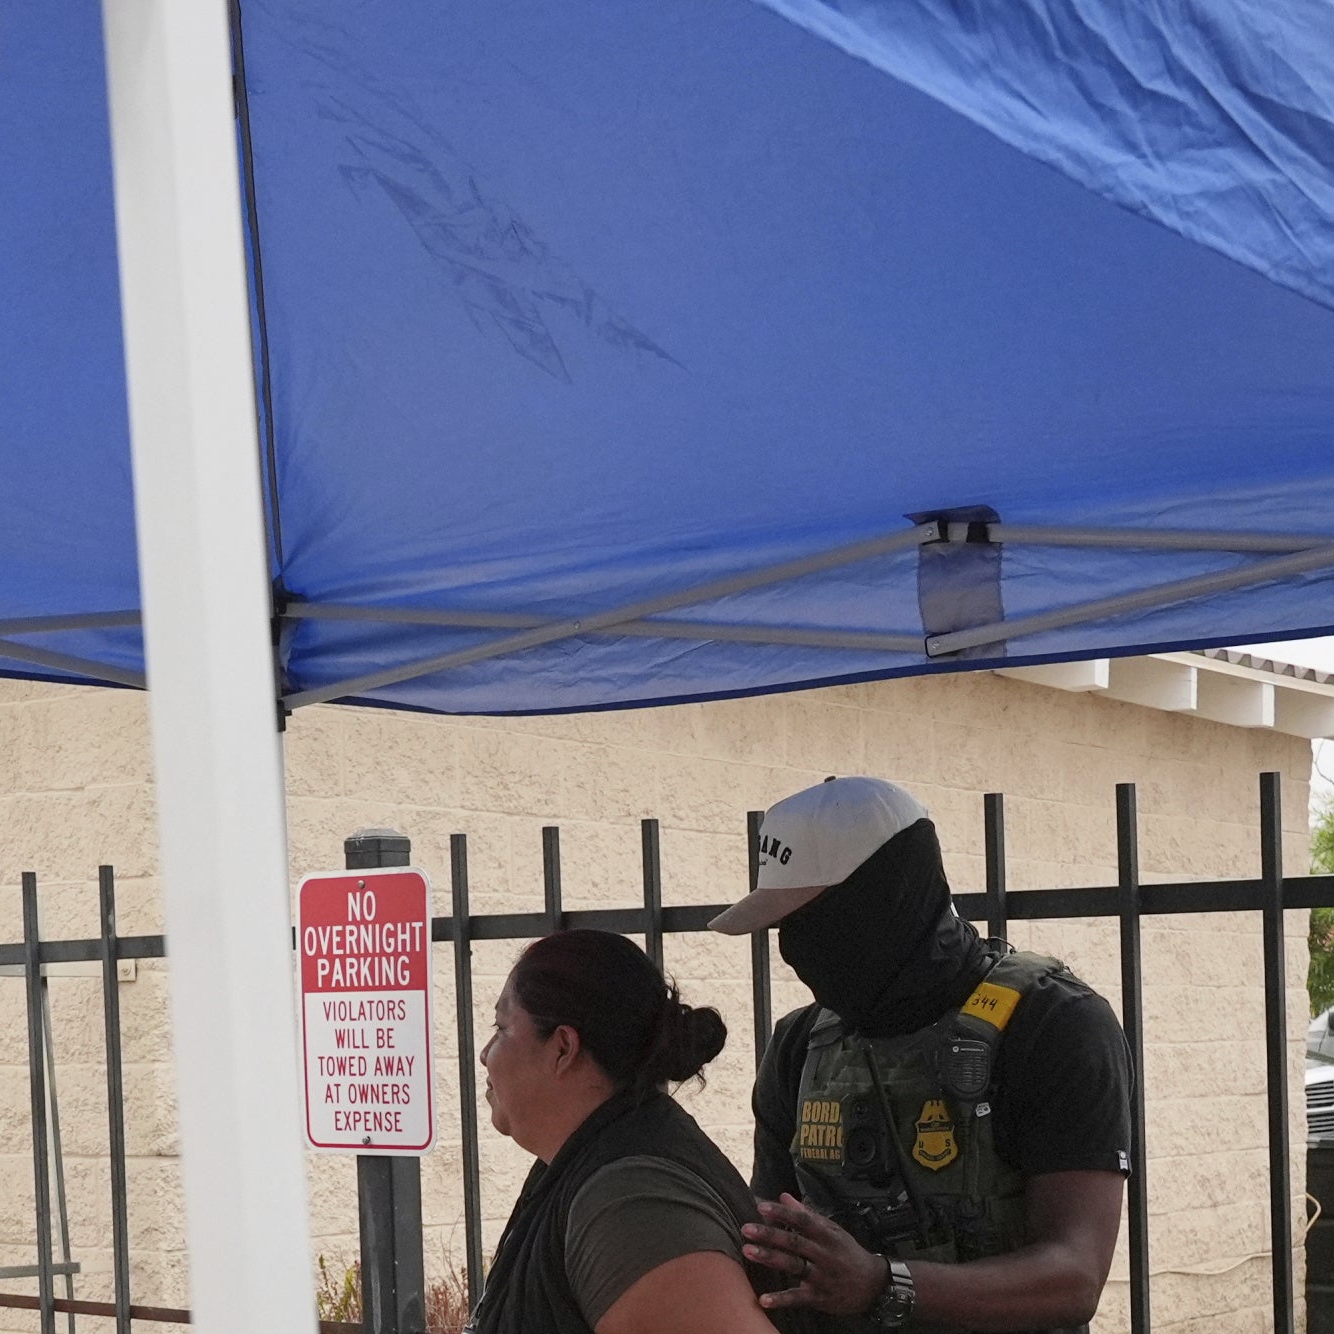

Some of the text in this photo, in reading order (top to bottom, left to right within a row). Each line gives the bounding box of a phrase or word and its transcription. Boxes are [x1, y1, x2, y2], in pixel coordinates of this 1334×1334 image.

[347, 890, 376, 921] NO
[304, 921, 423, 957] OVERNIGHT
[317, 955, 411, 988] PARKING
[323, 999, 406, 1021] VIOLATORS
[335, 1028, 395, 1049] WILL BE
[317, 1055, 415, 1077] TOWED AWAY
[325, 1083, 411, 1105] AT OWNERS
[335, 1111, 403, 1132] EXPENSE
[802, 1101, 842, 1123] BORD
